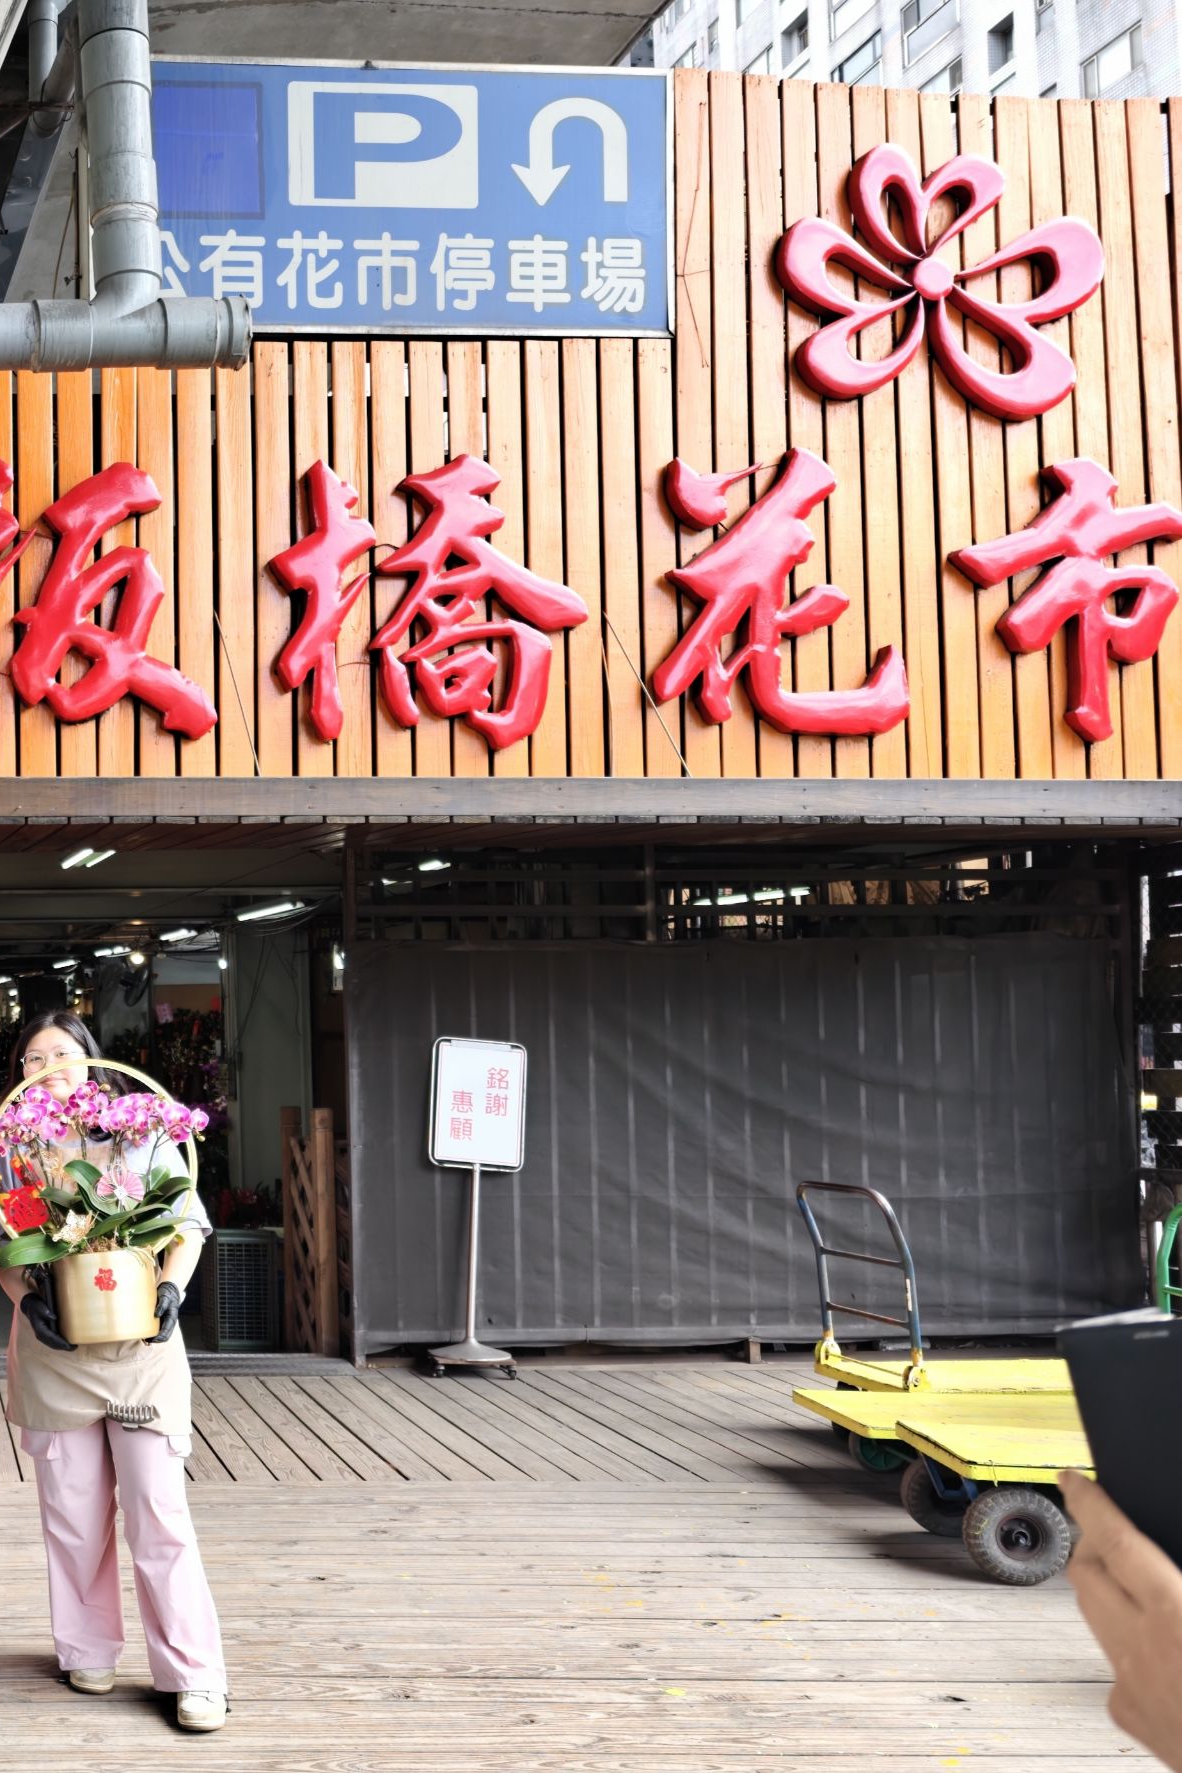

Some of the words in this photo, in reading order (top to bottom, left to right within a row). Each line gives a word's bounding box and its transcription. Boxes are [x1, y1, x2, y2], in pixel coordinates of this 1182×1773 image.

[312, 91, 464, 200] P
[449, 1090, 474, 1141] 惠顧
[485, 1067, 509, 1117] 銘謝
